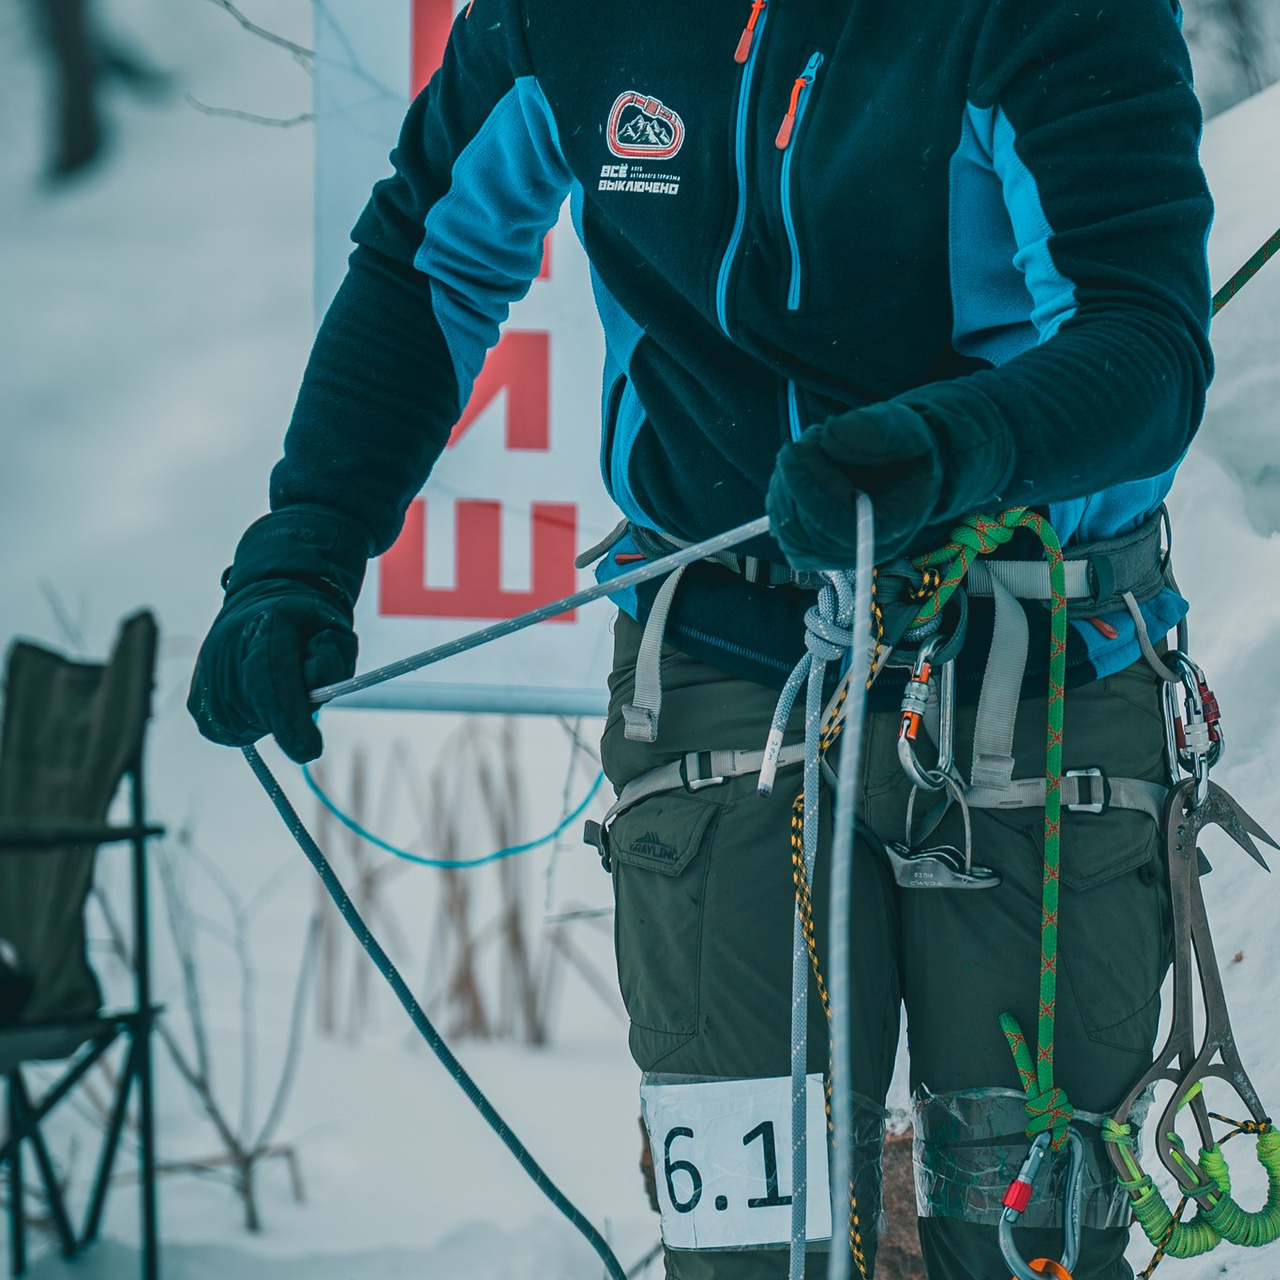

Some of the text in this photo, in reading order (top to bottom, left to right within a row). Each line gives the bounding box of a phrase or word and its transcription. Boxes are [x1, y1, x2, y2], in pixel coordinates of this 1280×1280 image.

[600, 163, 629, 178] ВСЁ
[597, 179, 680, 195] ВЫКЛЮЧЕНО
[664, 1120, 793, 1214] 6.1
